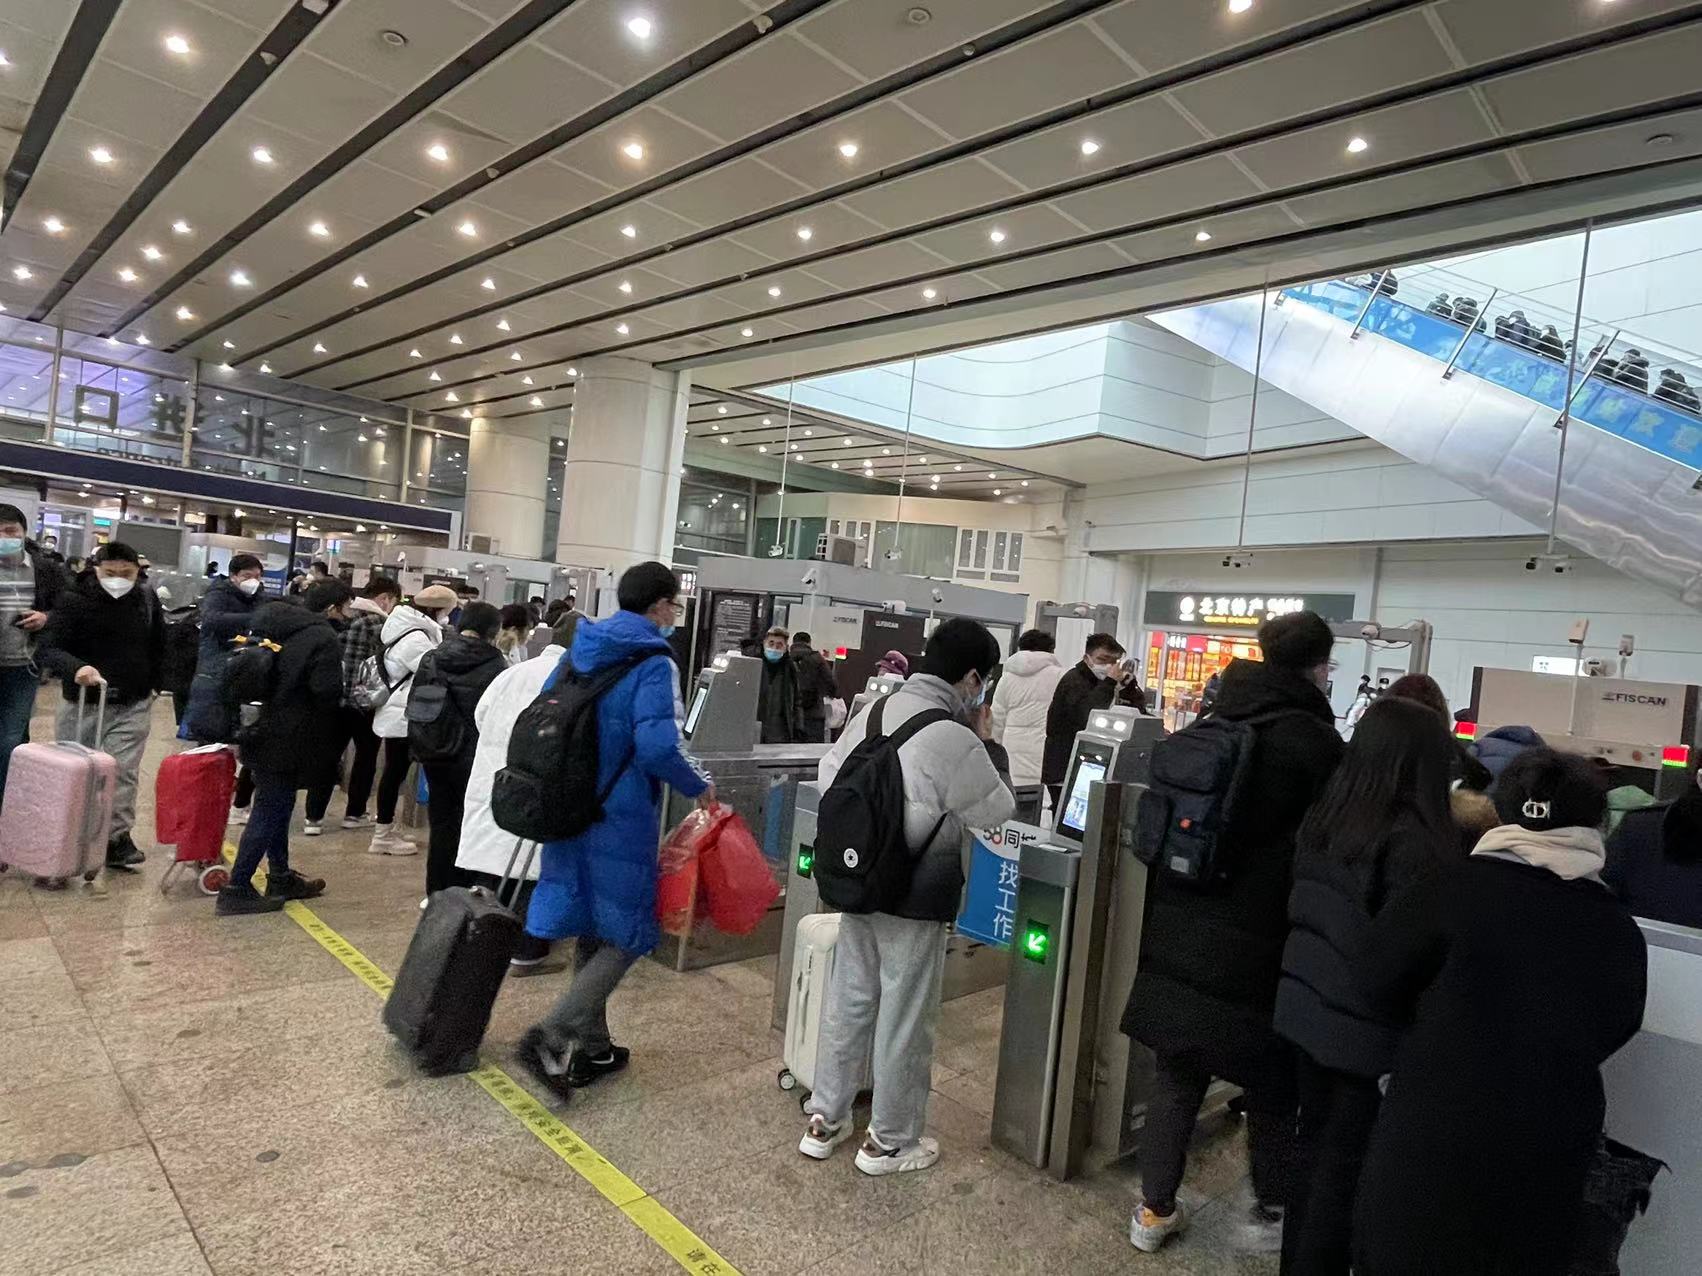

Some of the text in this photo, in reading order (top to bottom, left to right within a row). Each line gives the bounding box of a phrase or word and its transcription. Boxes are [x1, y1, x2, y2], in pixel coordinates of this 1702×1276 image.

[1616, 693, 1667, 706] FISCAN
[993, 861, 1018, 938] 找工作
